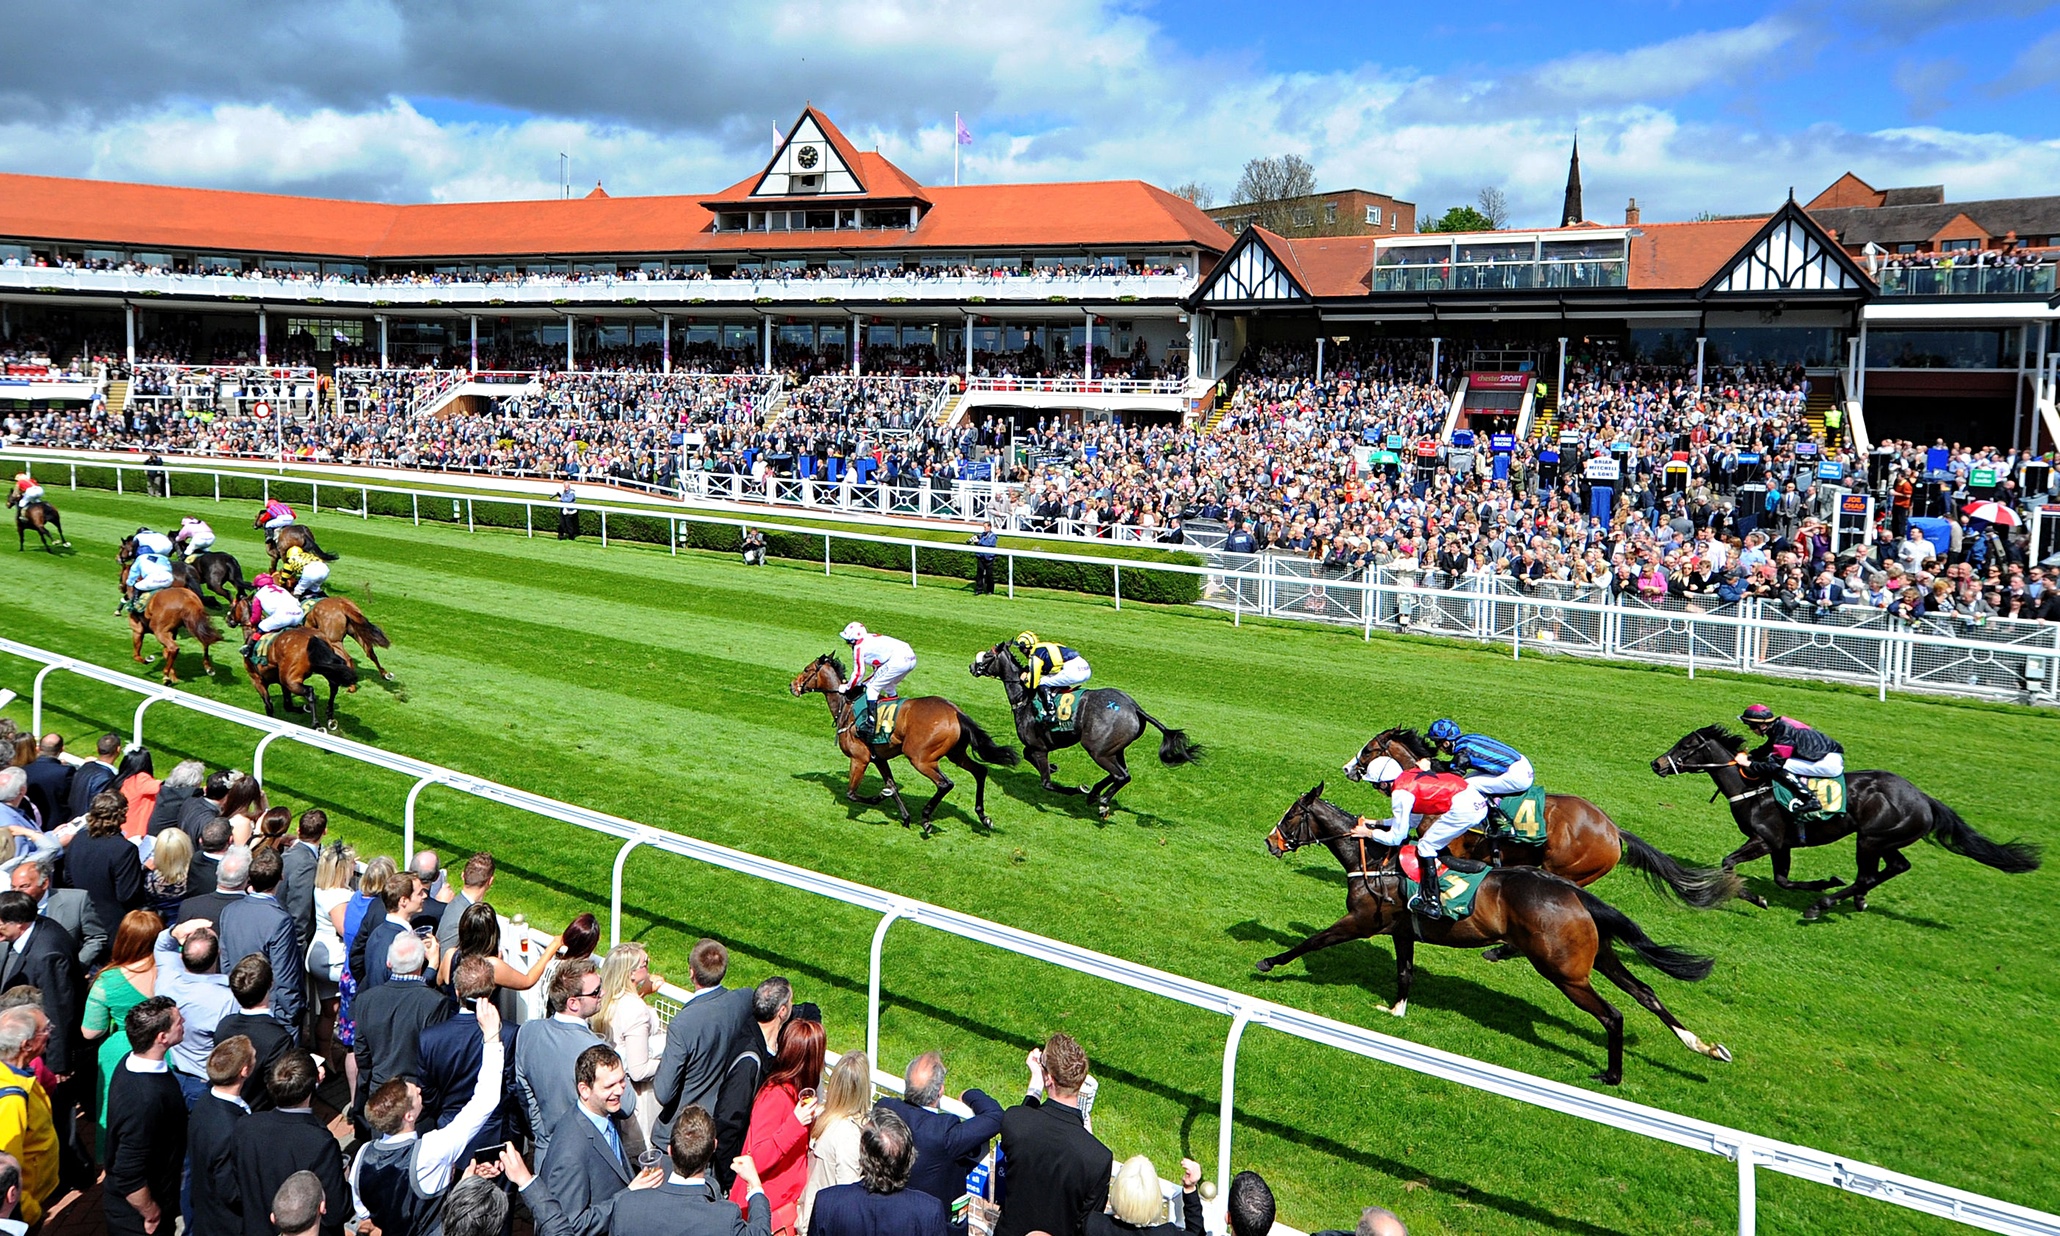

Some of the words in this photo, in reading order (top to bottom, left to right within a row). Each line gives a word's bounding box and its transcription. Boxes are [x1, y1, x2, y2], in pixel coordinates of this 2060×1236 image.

[874, 703, 898, 734] 14
[1057, 692, 1075, 721] 8
[1513, 799, 1540, 837] 4
